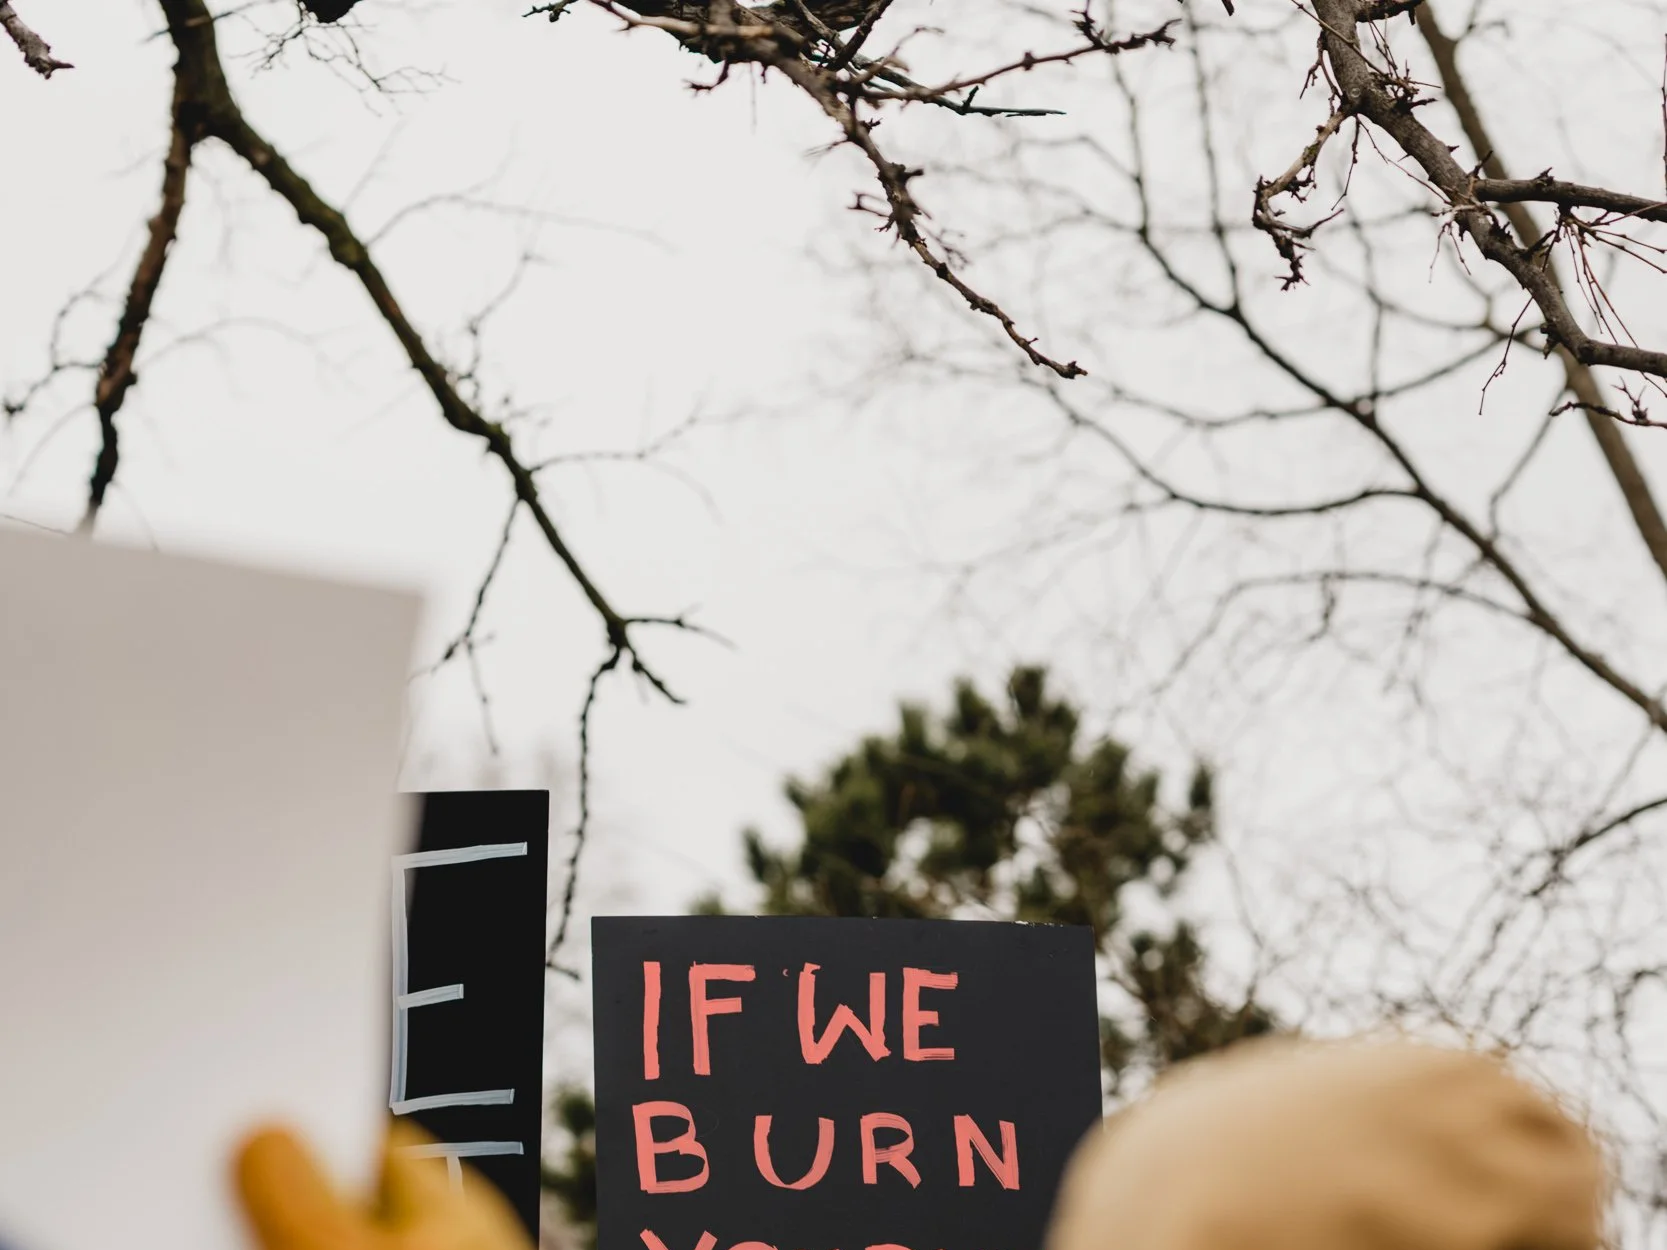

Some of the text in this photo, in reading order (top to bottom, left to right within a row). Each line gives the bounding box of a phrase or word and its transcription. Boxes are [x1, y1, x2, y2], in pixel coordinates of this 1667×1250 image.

[643, 960, 960, 1081] IF WE
[632, 1100, 1021, 1194] BURN
